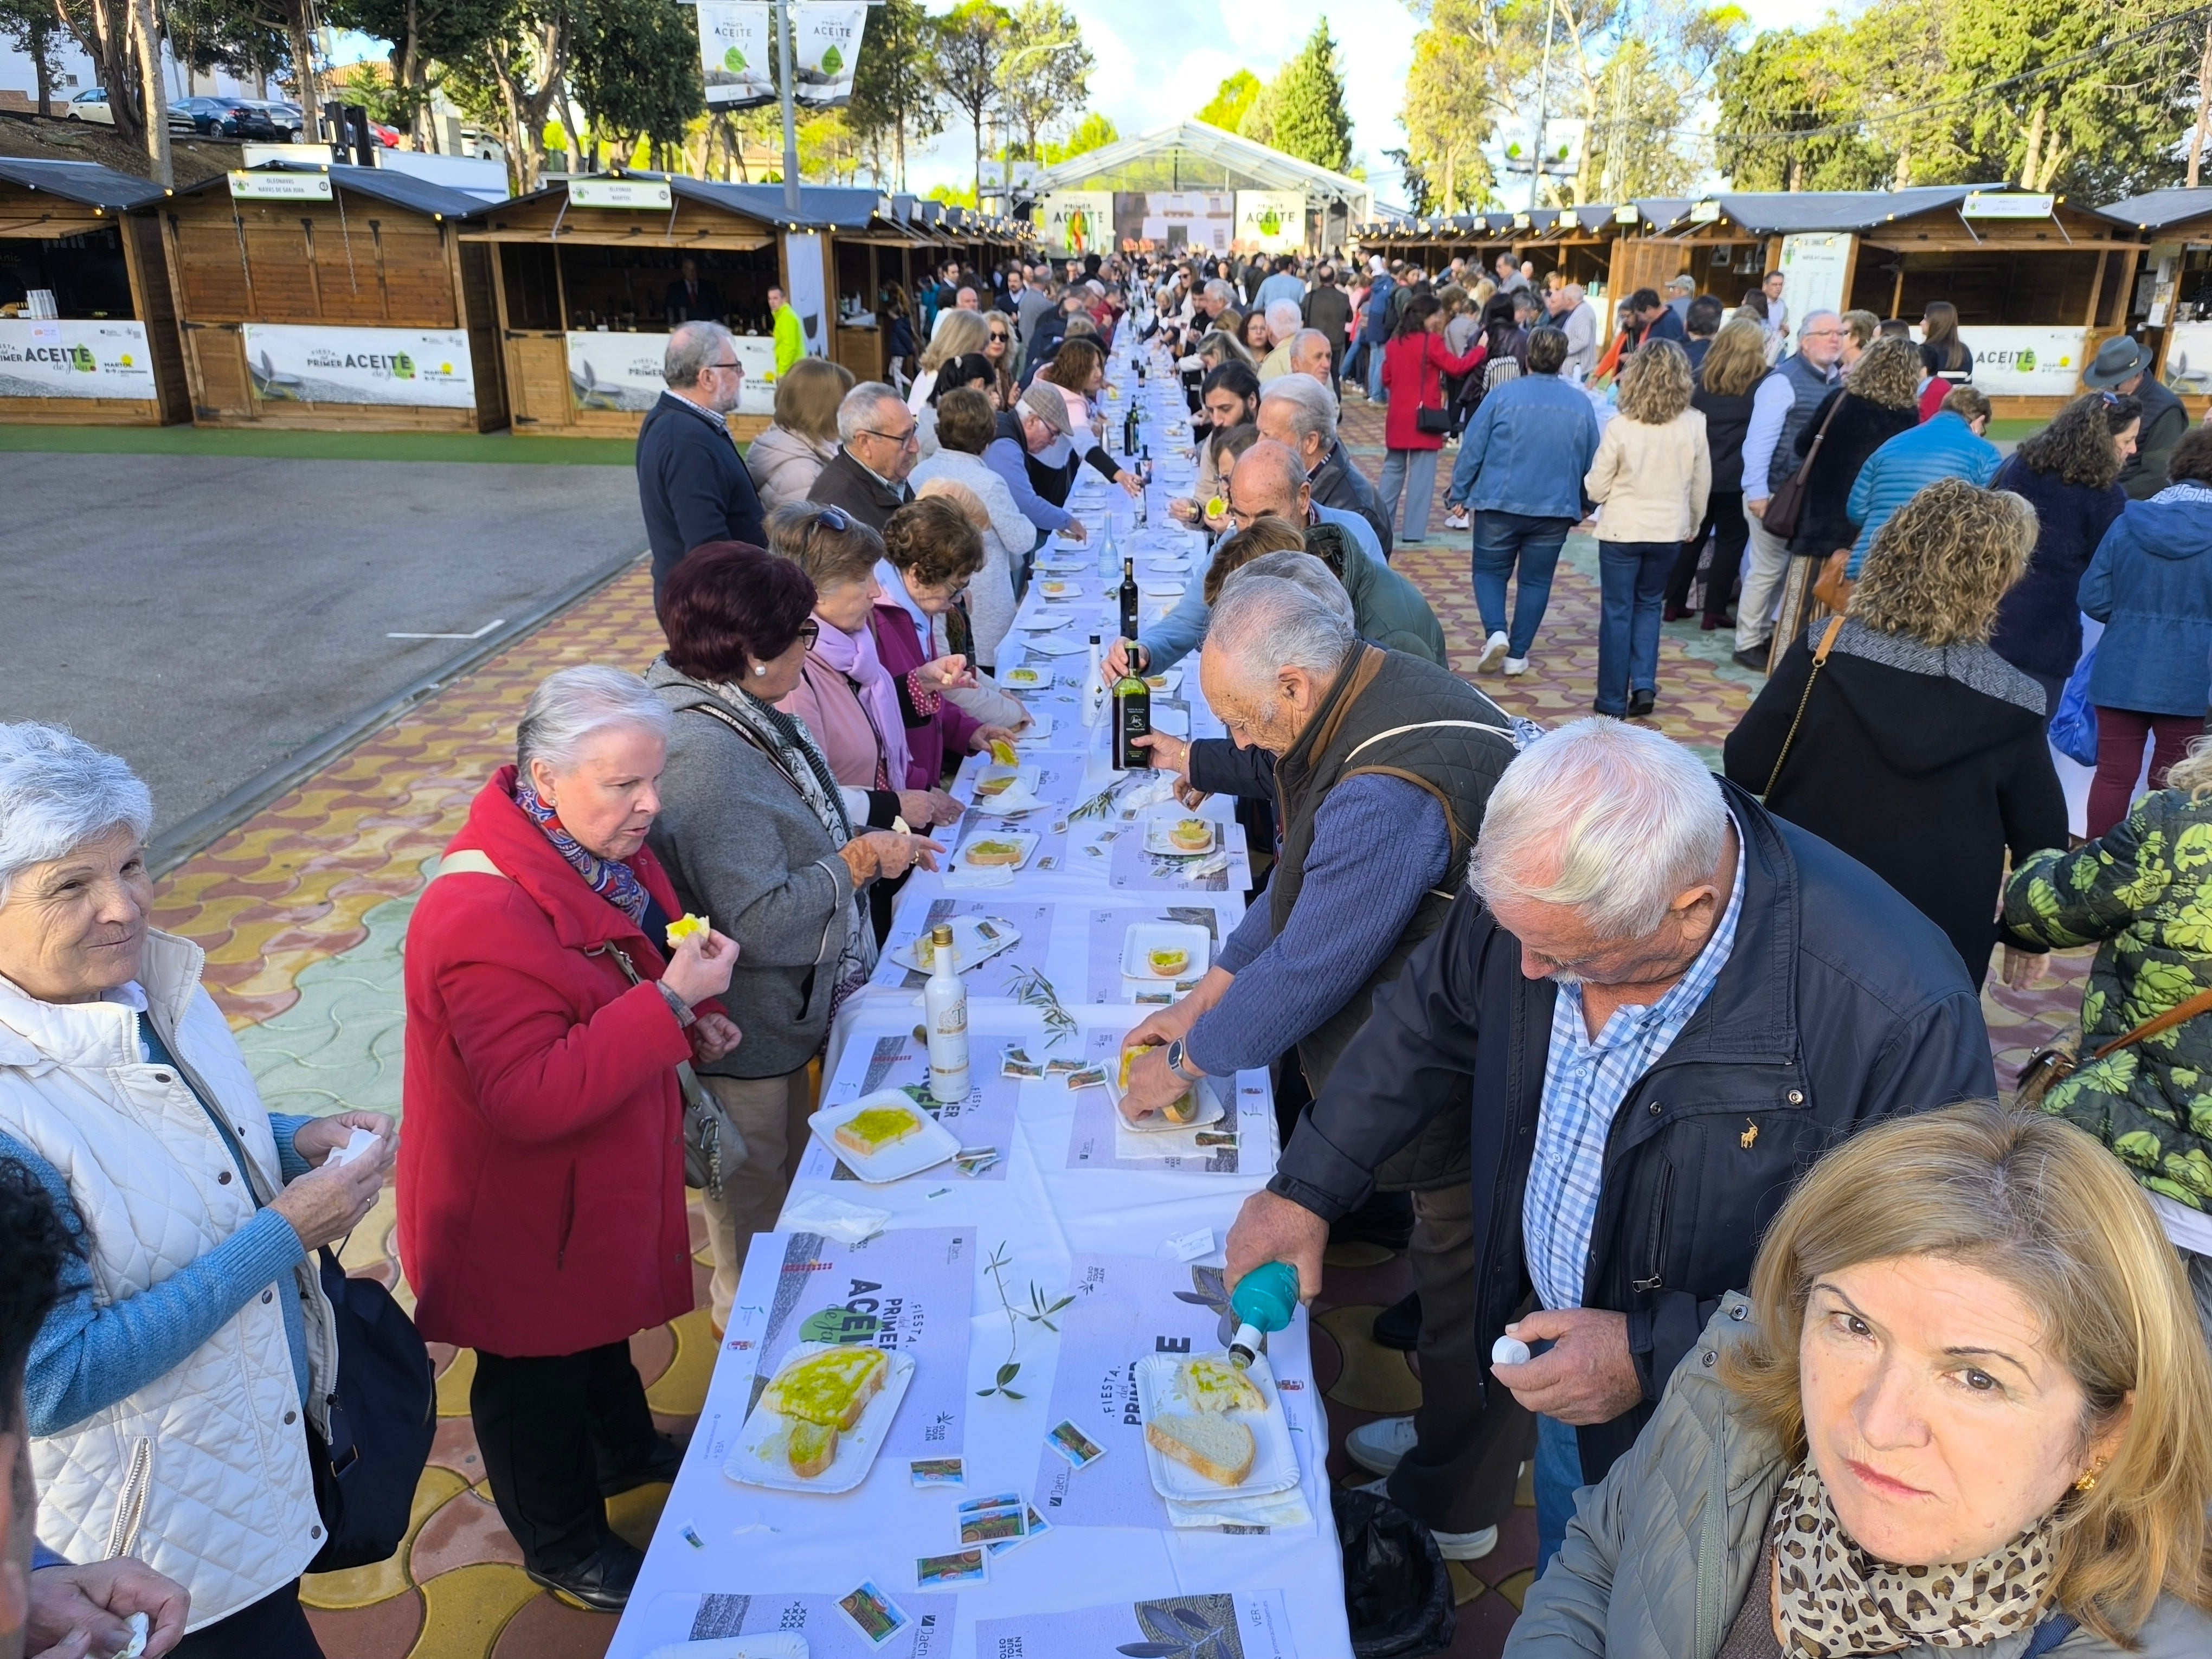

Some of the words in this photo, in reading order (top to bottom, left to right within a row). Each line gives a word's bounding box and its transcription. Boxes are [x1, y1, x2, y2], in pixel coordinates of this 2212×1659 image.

[715, 26, 752, 37] ACEITE
[814, 26, 851, 37] ACEITE
[1246, 211, 1295, 223] ACEITE
[25, 348, 91, 363] ACEITE
[307, 358, 343, 368] PRIMER
[345, 354, 411, 370] ACEITE
[1975, 351, 2034, 363] ACEITE
[906, 1302, 924, 1347] FIESTA
[1101, 1365, 1121, 1417] FIESTA
[1110, 1384, 1128, 1399] del
[1054, 1472, 1067, 1496] Jaén
[1250, 1609, 1262, 1627] VER
[917, 1628, 934, 1656] Jaén
